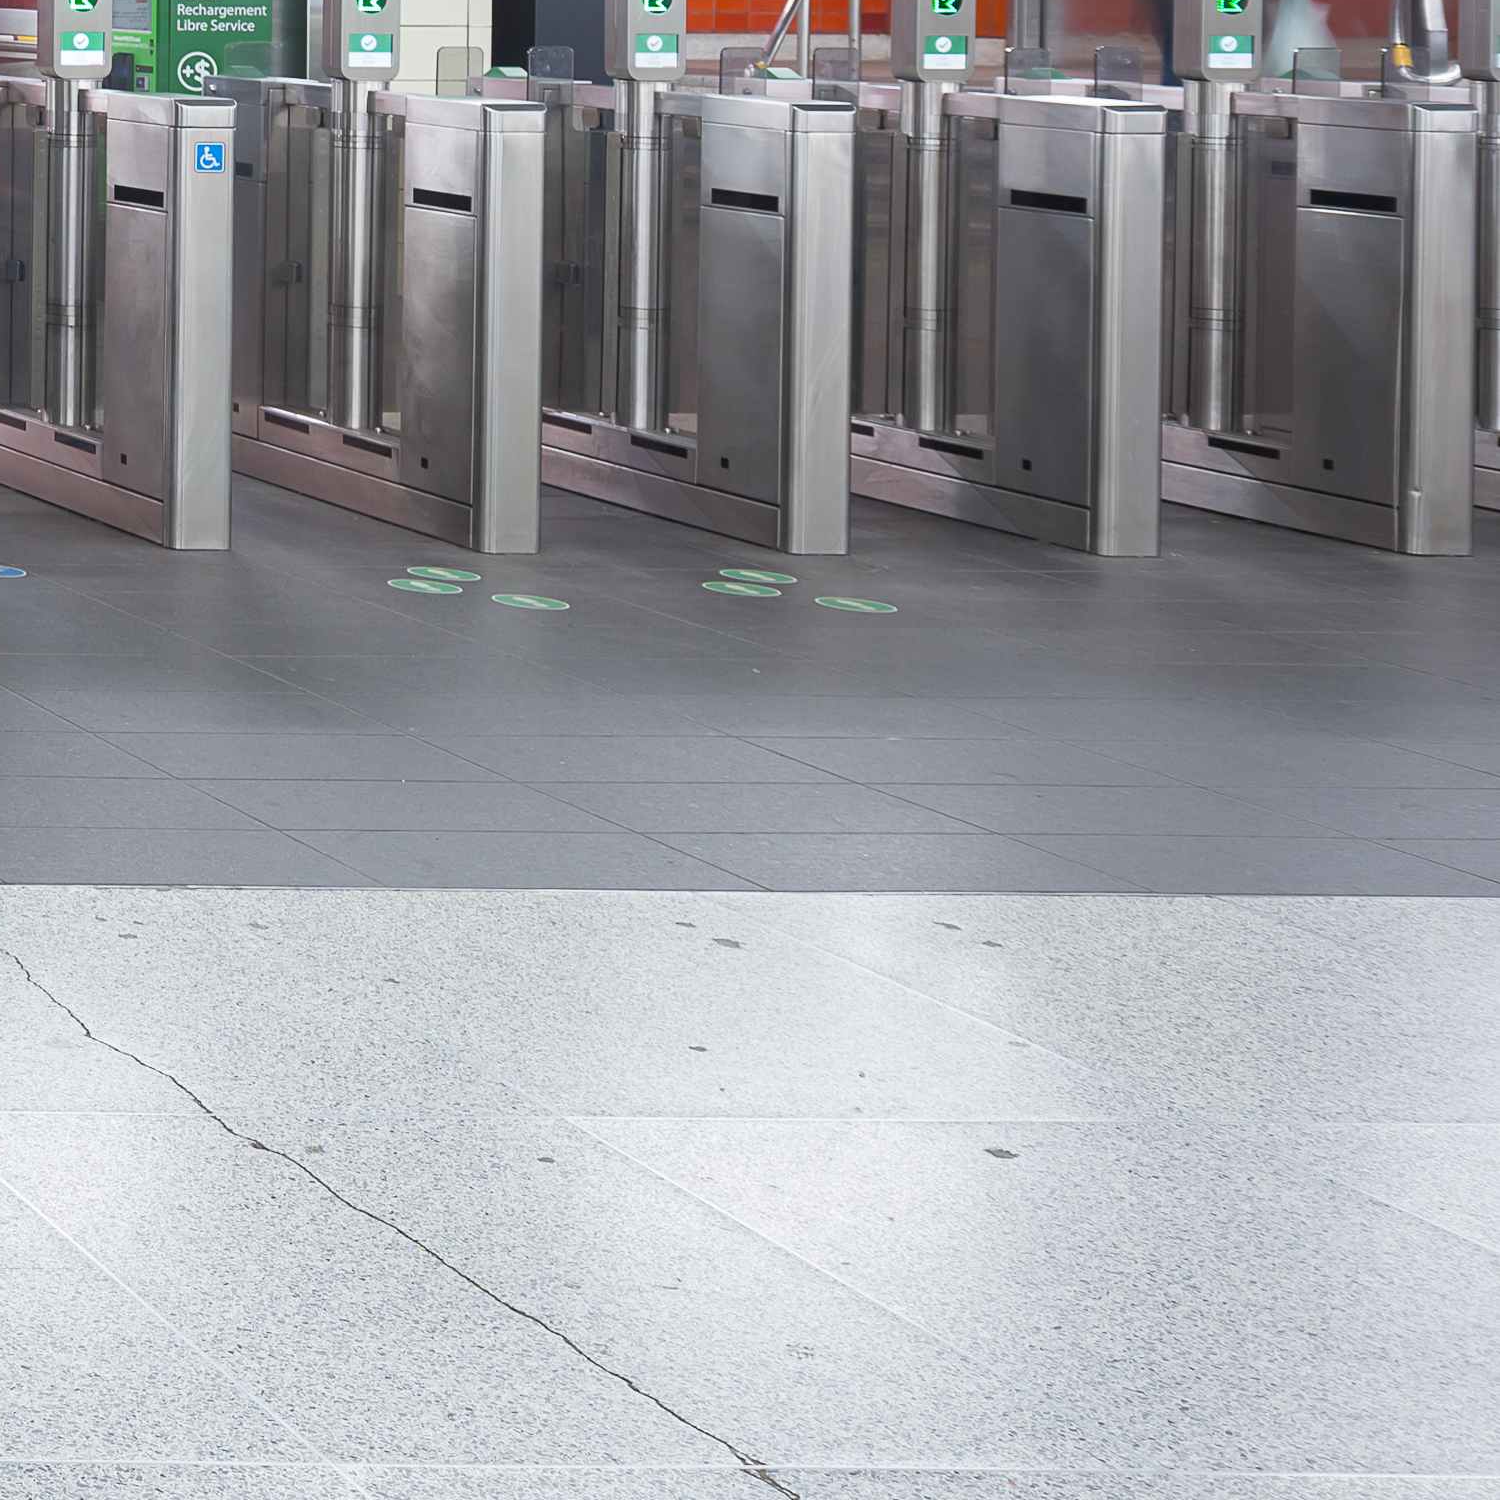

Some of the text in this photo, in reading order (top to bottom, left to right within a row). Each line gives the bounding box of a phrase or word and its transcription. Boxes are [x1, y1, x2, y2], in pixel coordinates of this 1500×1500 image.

[177, 3, 267, 19] Rechargement
[176, 18, 255, 32] Libre Service
